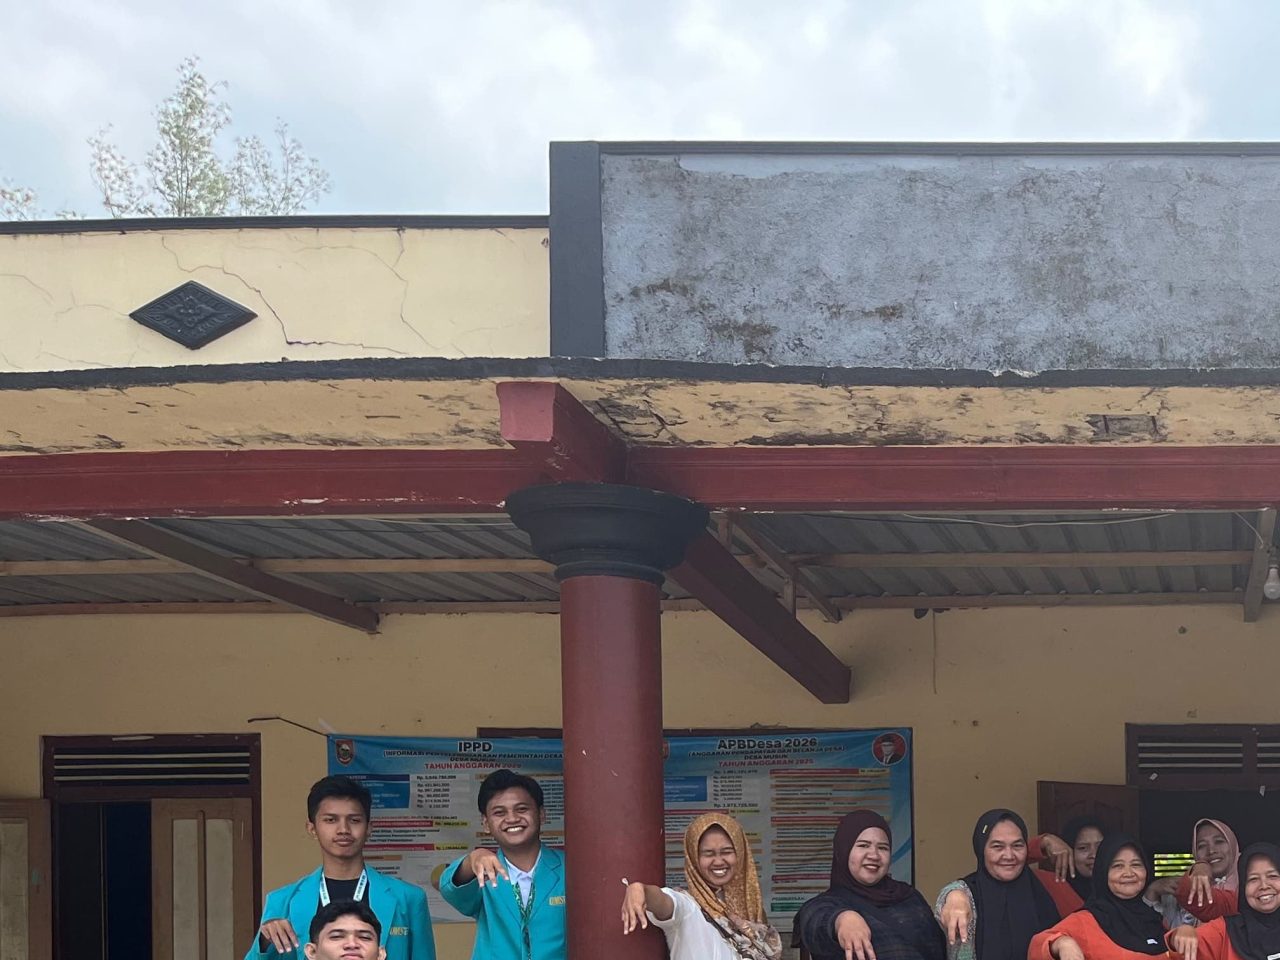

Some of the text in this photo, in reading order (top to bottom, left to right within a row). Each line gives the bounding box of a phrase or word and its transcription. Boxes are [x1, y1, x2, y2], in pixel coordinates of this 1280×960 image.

[458, 741, 493, 752] IPPD
[717, 737, 817, 750] APBDesa 2026
